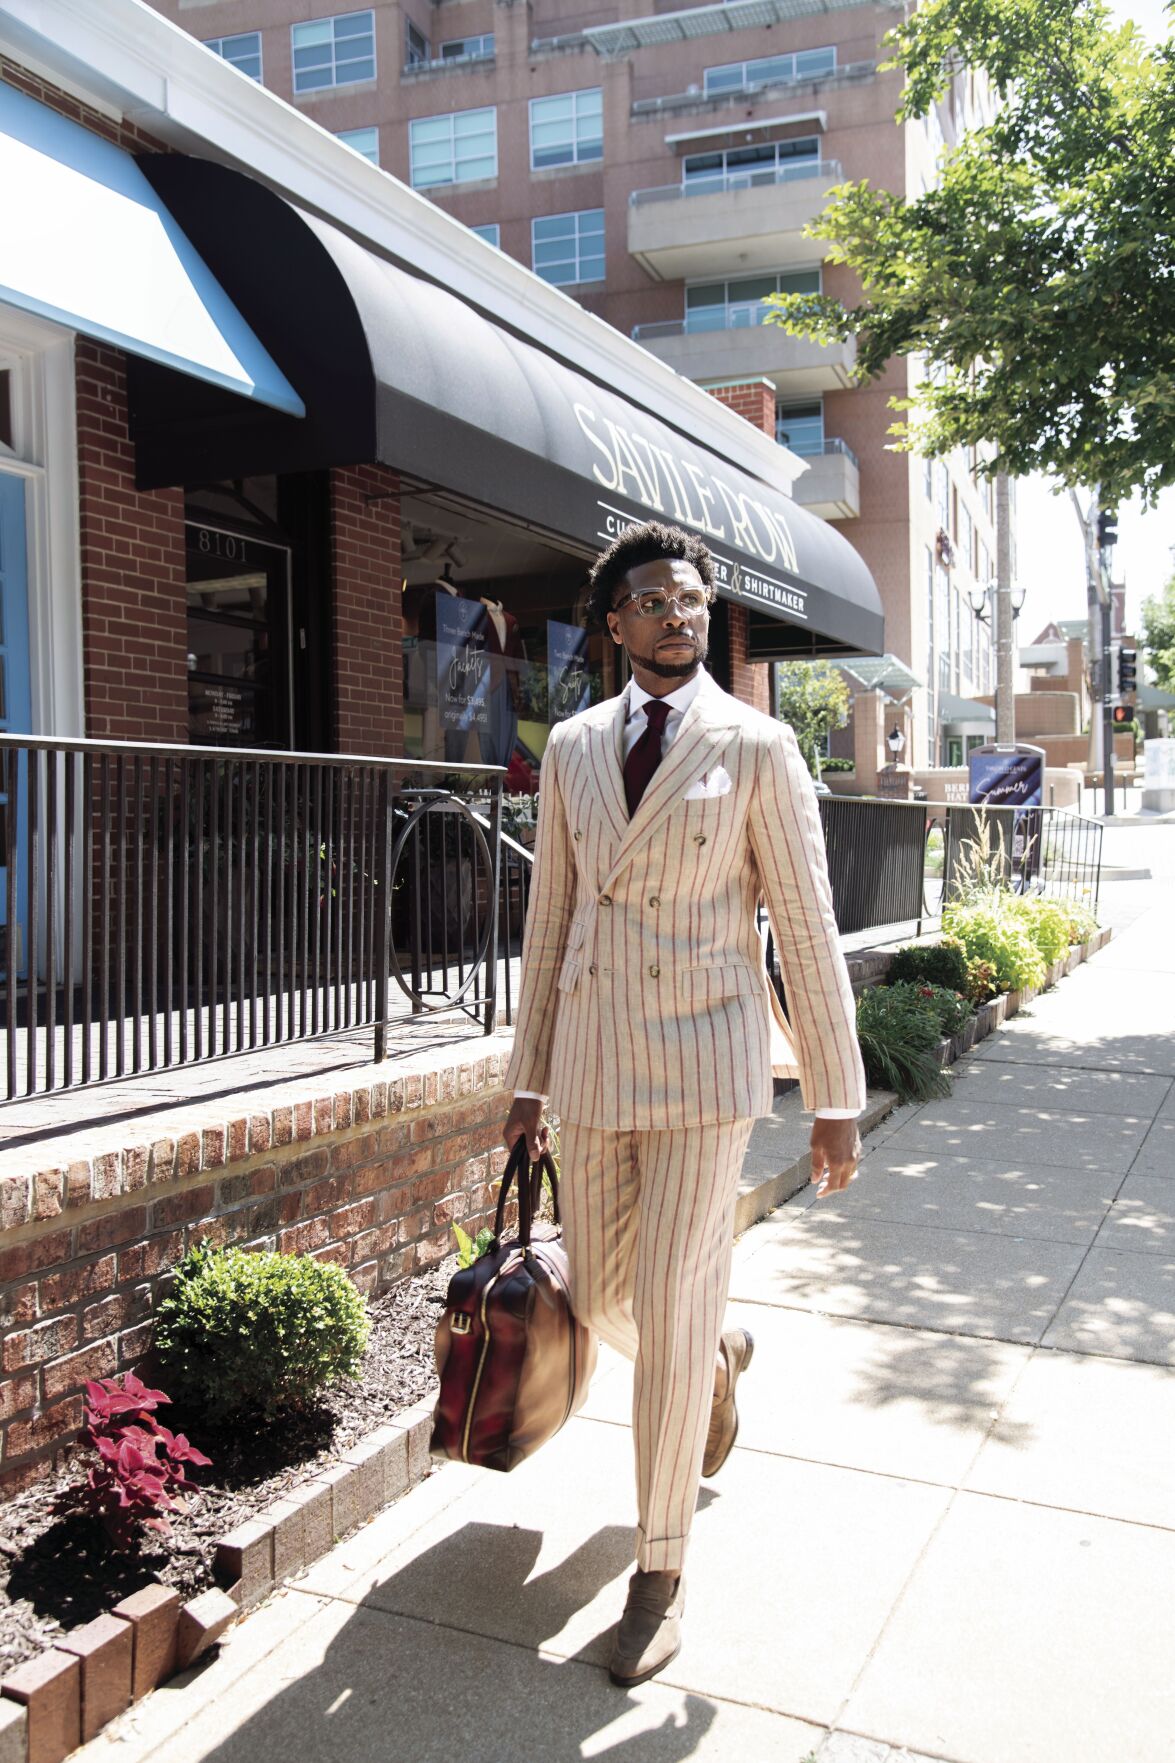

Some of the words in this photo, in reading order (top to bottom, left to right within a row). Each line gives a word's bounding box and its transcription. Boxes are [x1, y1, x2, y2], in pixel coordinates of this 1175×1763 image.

[574, 403, 725, 538] SAVILE
[711, 475, 799, 573] ROW
[199, 530, 247, 562] 8101
[731, 562, 742, 595] &
[744, 575, 804, 612] SHIRTMAKER
[449, 644, 485, 690] Jackets
[976, 778, 1028, 804] Summer
